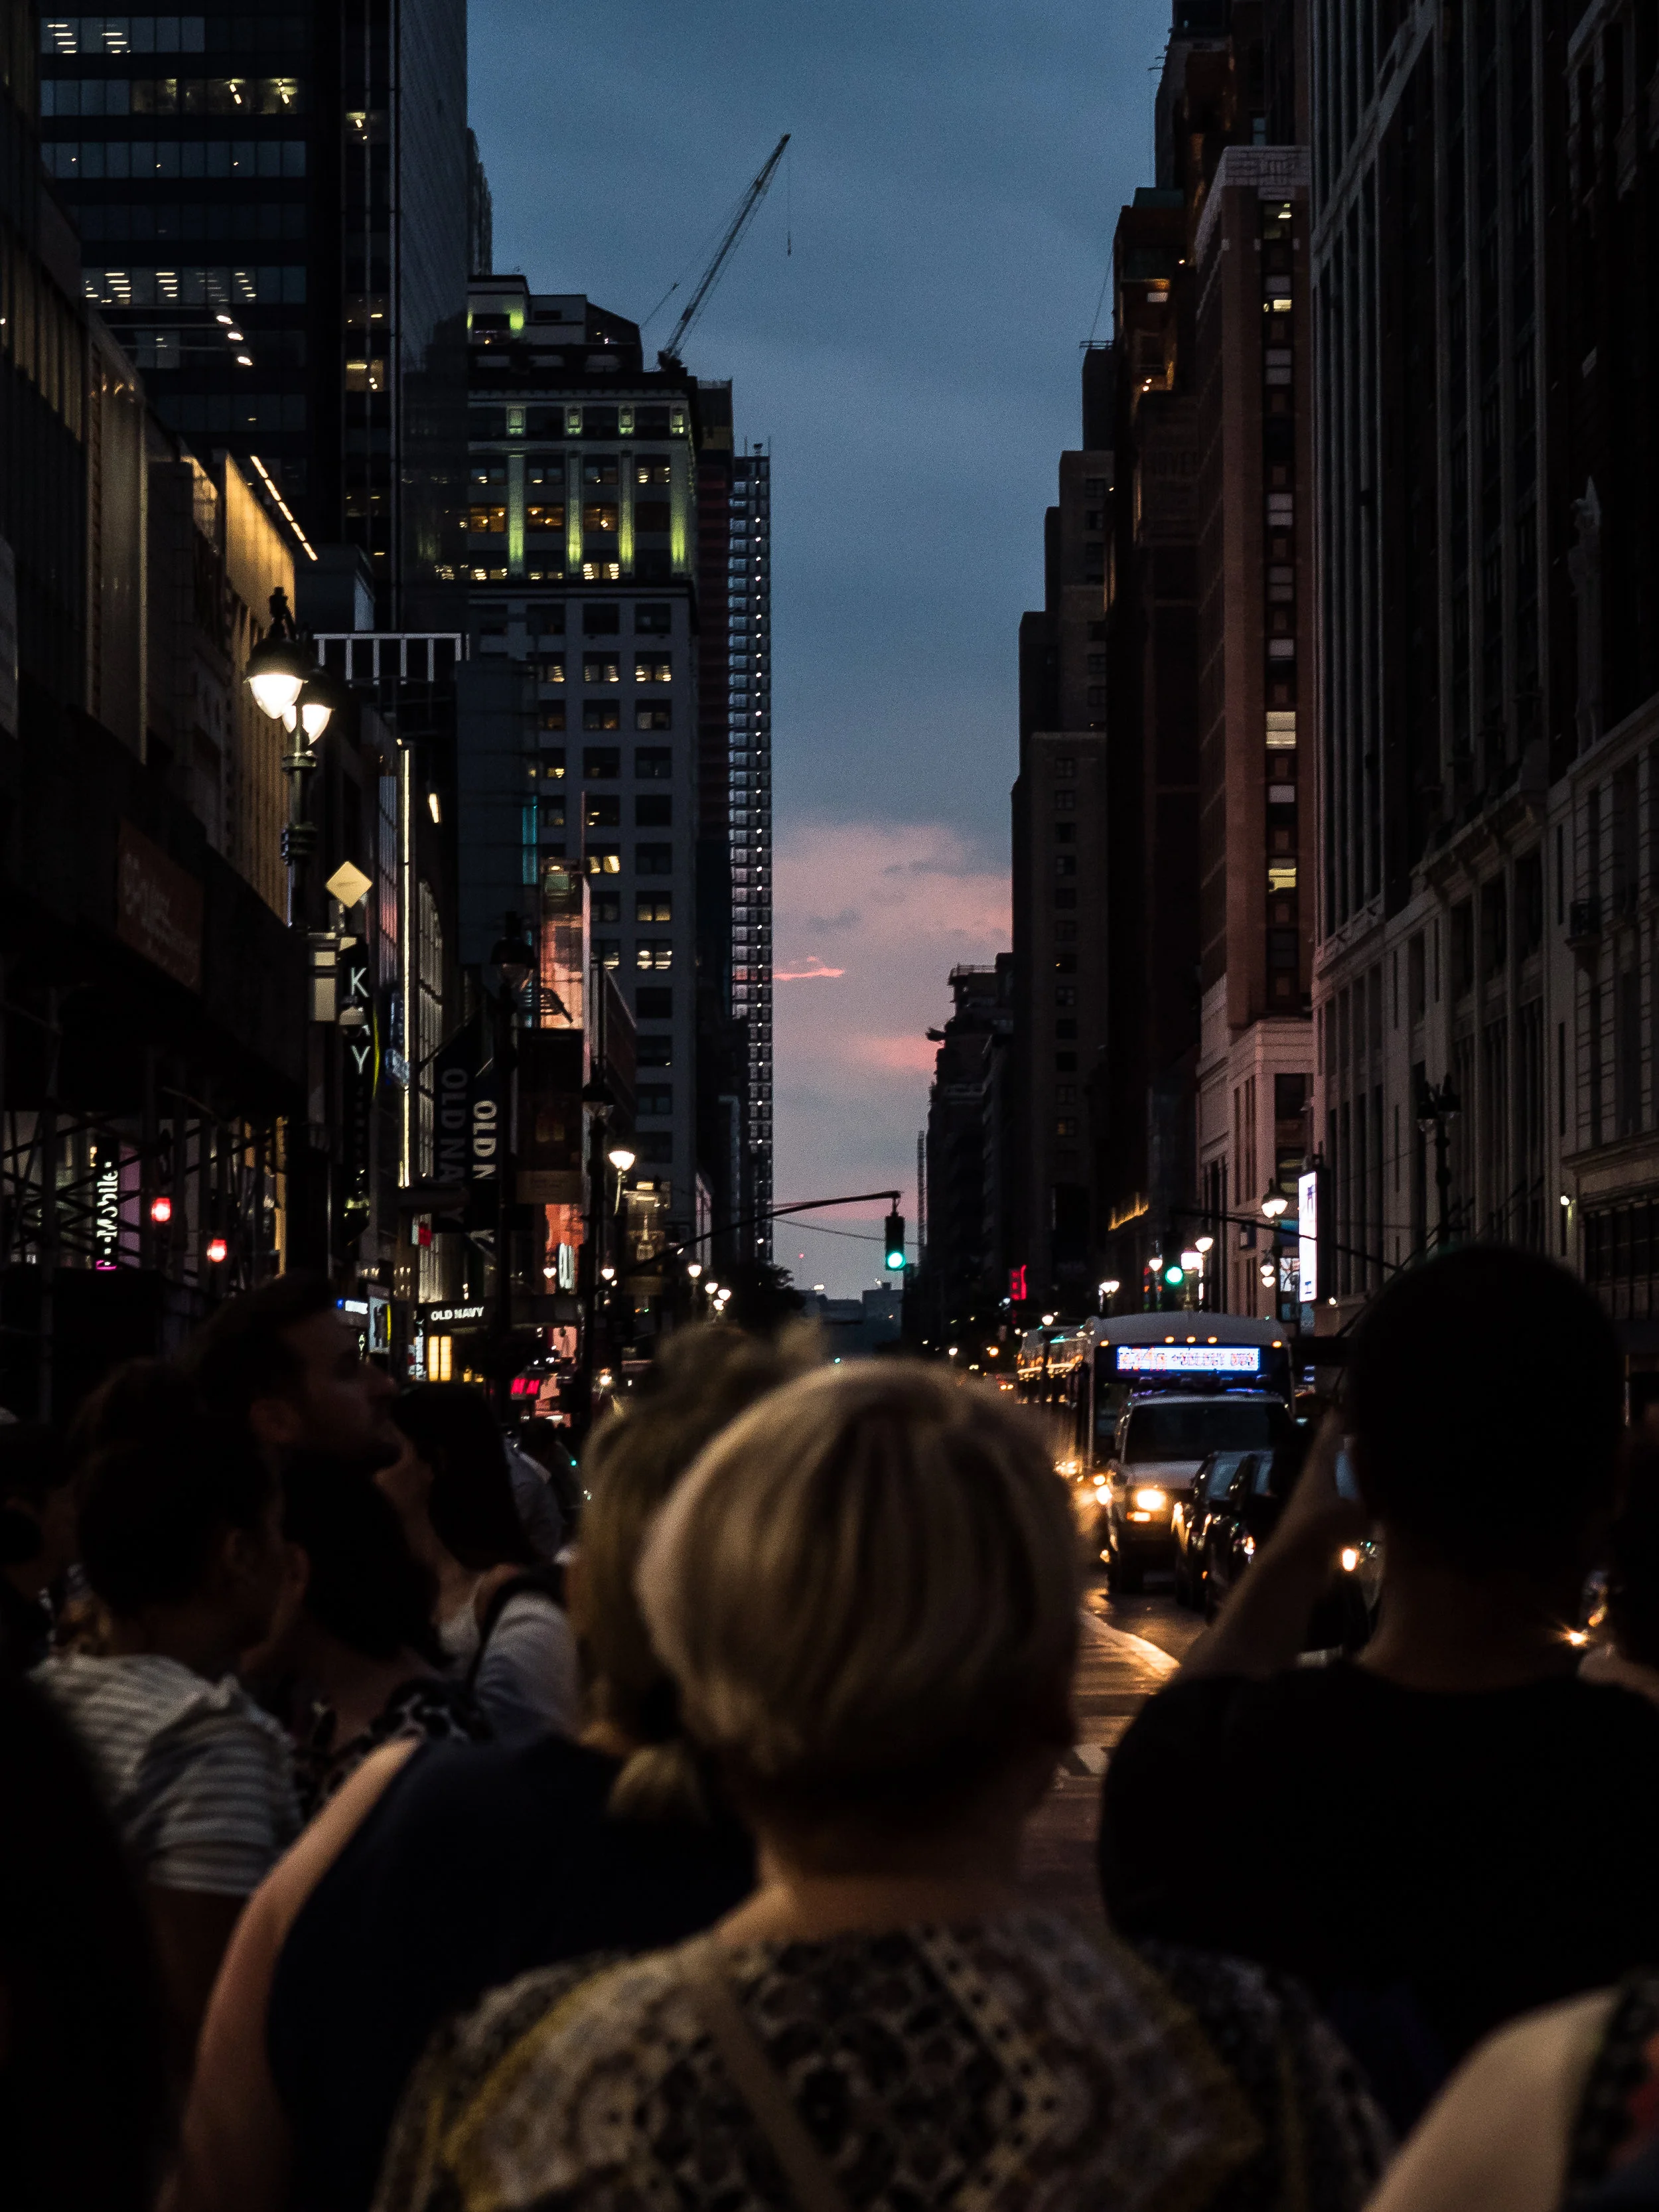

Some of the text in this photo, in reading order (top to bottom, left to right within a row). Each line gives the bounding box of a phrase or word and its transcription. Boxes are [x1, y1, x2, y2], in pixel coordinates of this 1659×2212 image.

[349, 966, 372, 1076] KY
[437, 1067, 469, 1224] OLD NAY
[472, 1098, 498, 1158] OLD
[430, 1305, 484, 1321] OLD NAVY
